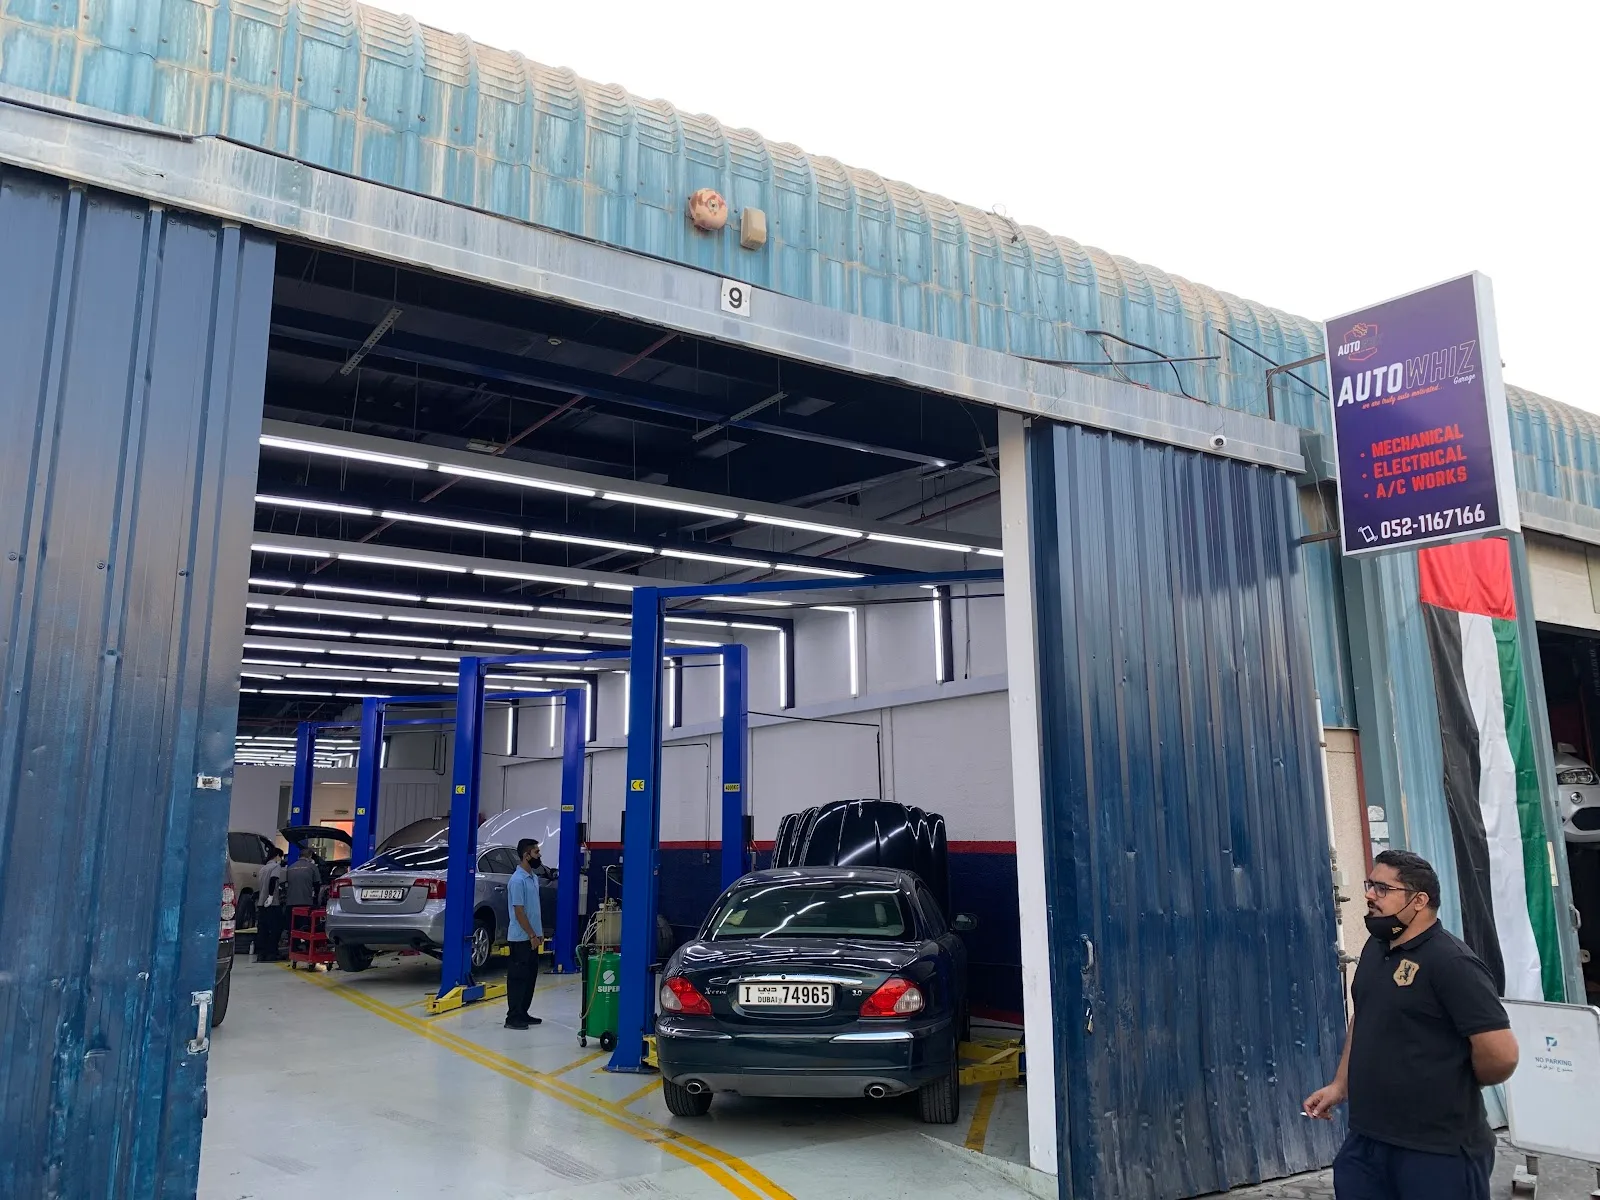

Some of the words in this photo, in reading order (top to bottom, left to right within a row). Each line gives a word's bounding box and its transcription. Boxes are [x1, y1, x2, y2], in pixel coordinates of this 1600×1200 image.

[728, 286, 743, 309] 9
[1453, 373, 1476, 385] Garage
[1371, 400, 1380, 408] are
[1381, 395, 1396, 406] truly
[1371, 424, 1463, 457] MECHANICAL
[1373, 444, 1468, 479] ELECTRICAL
[1376, 478, 1406, 499] A/C
[1411, 465, 1468, 492] WORKS
[1380, 504, 1486, 538] 052-1167166
[782, 986, 830, 1004] 74965
[1545, 1058, 1572, 1066] PARKING
